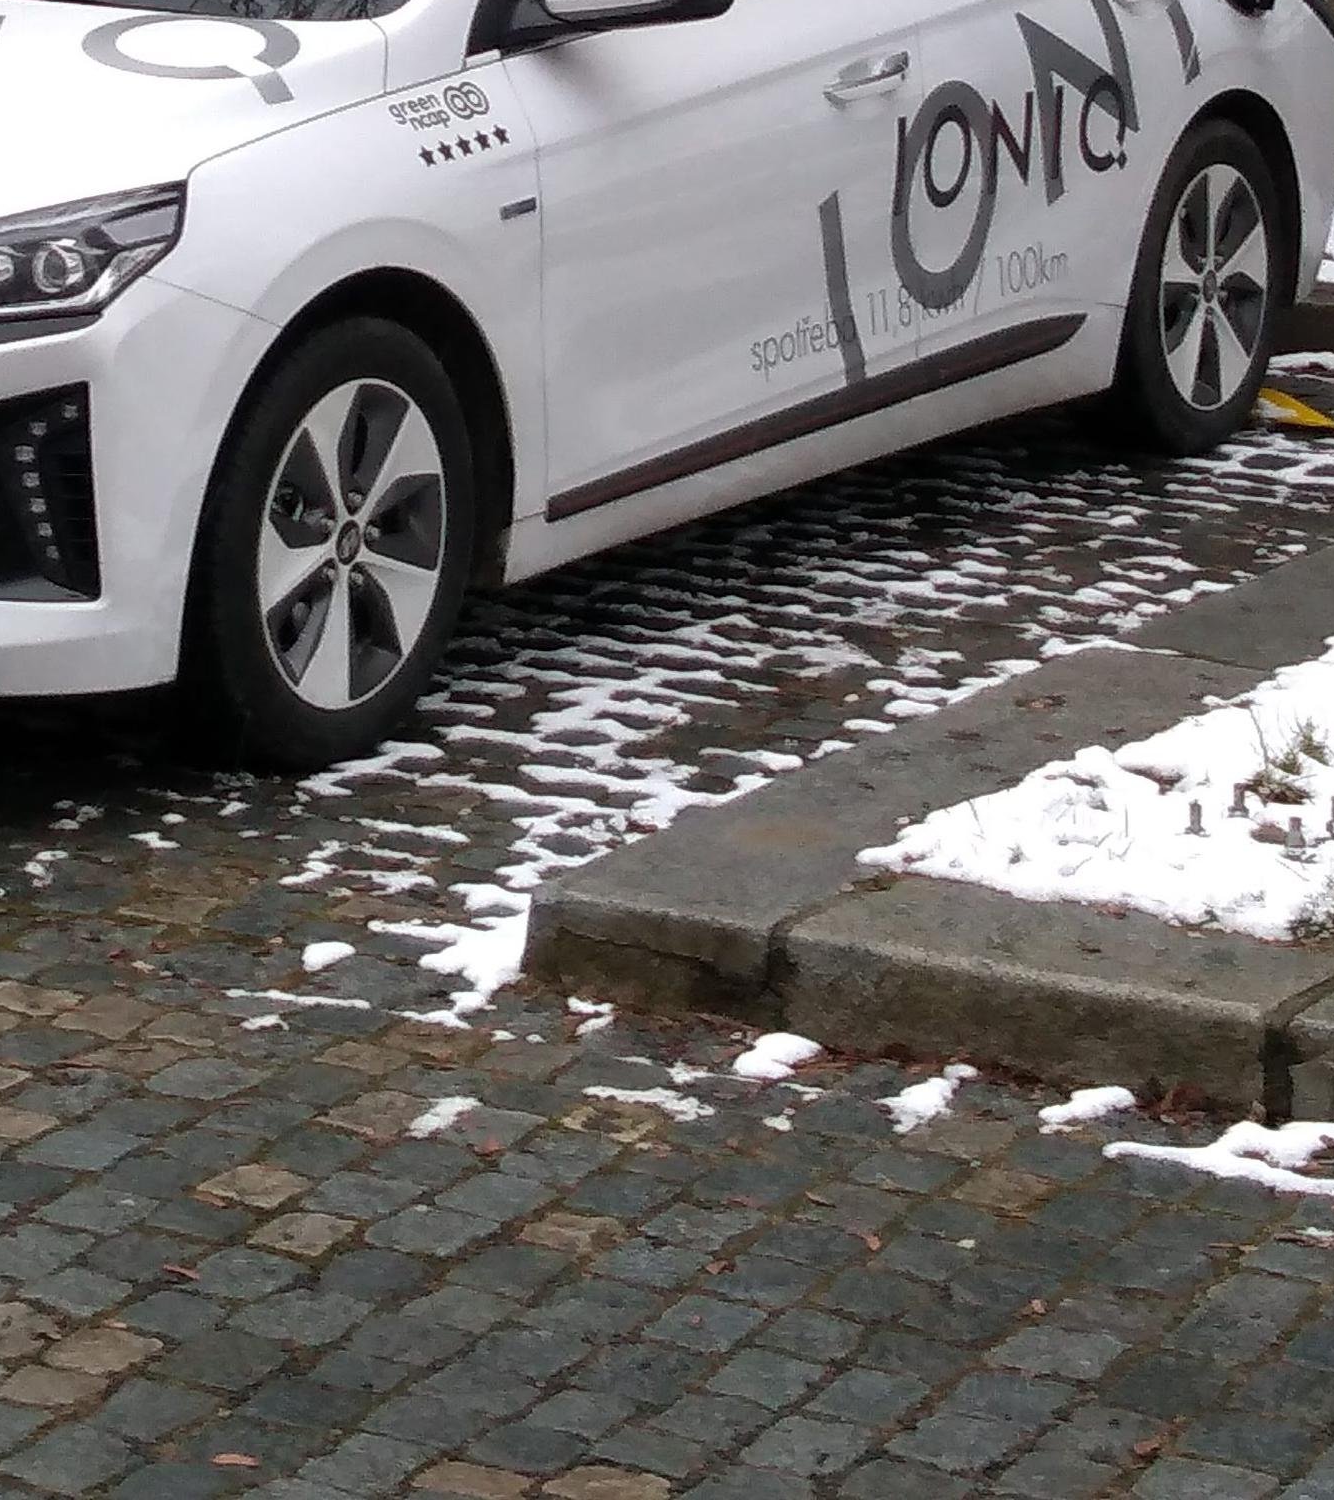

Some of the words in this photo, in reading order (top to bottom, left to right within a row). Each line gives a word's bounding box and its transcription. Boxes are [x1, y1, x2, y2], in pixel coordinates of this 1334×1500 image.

[388, 93, 442, 125] green
[410, 109, 452, 131] ncap
[894, 76, 1126, 217] IONIQ
[996, 242, 1068, 297] 100km
